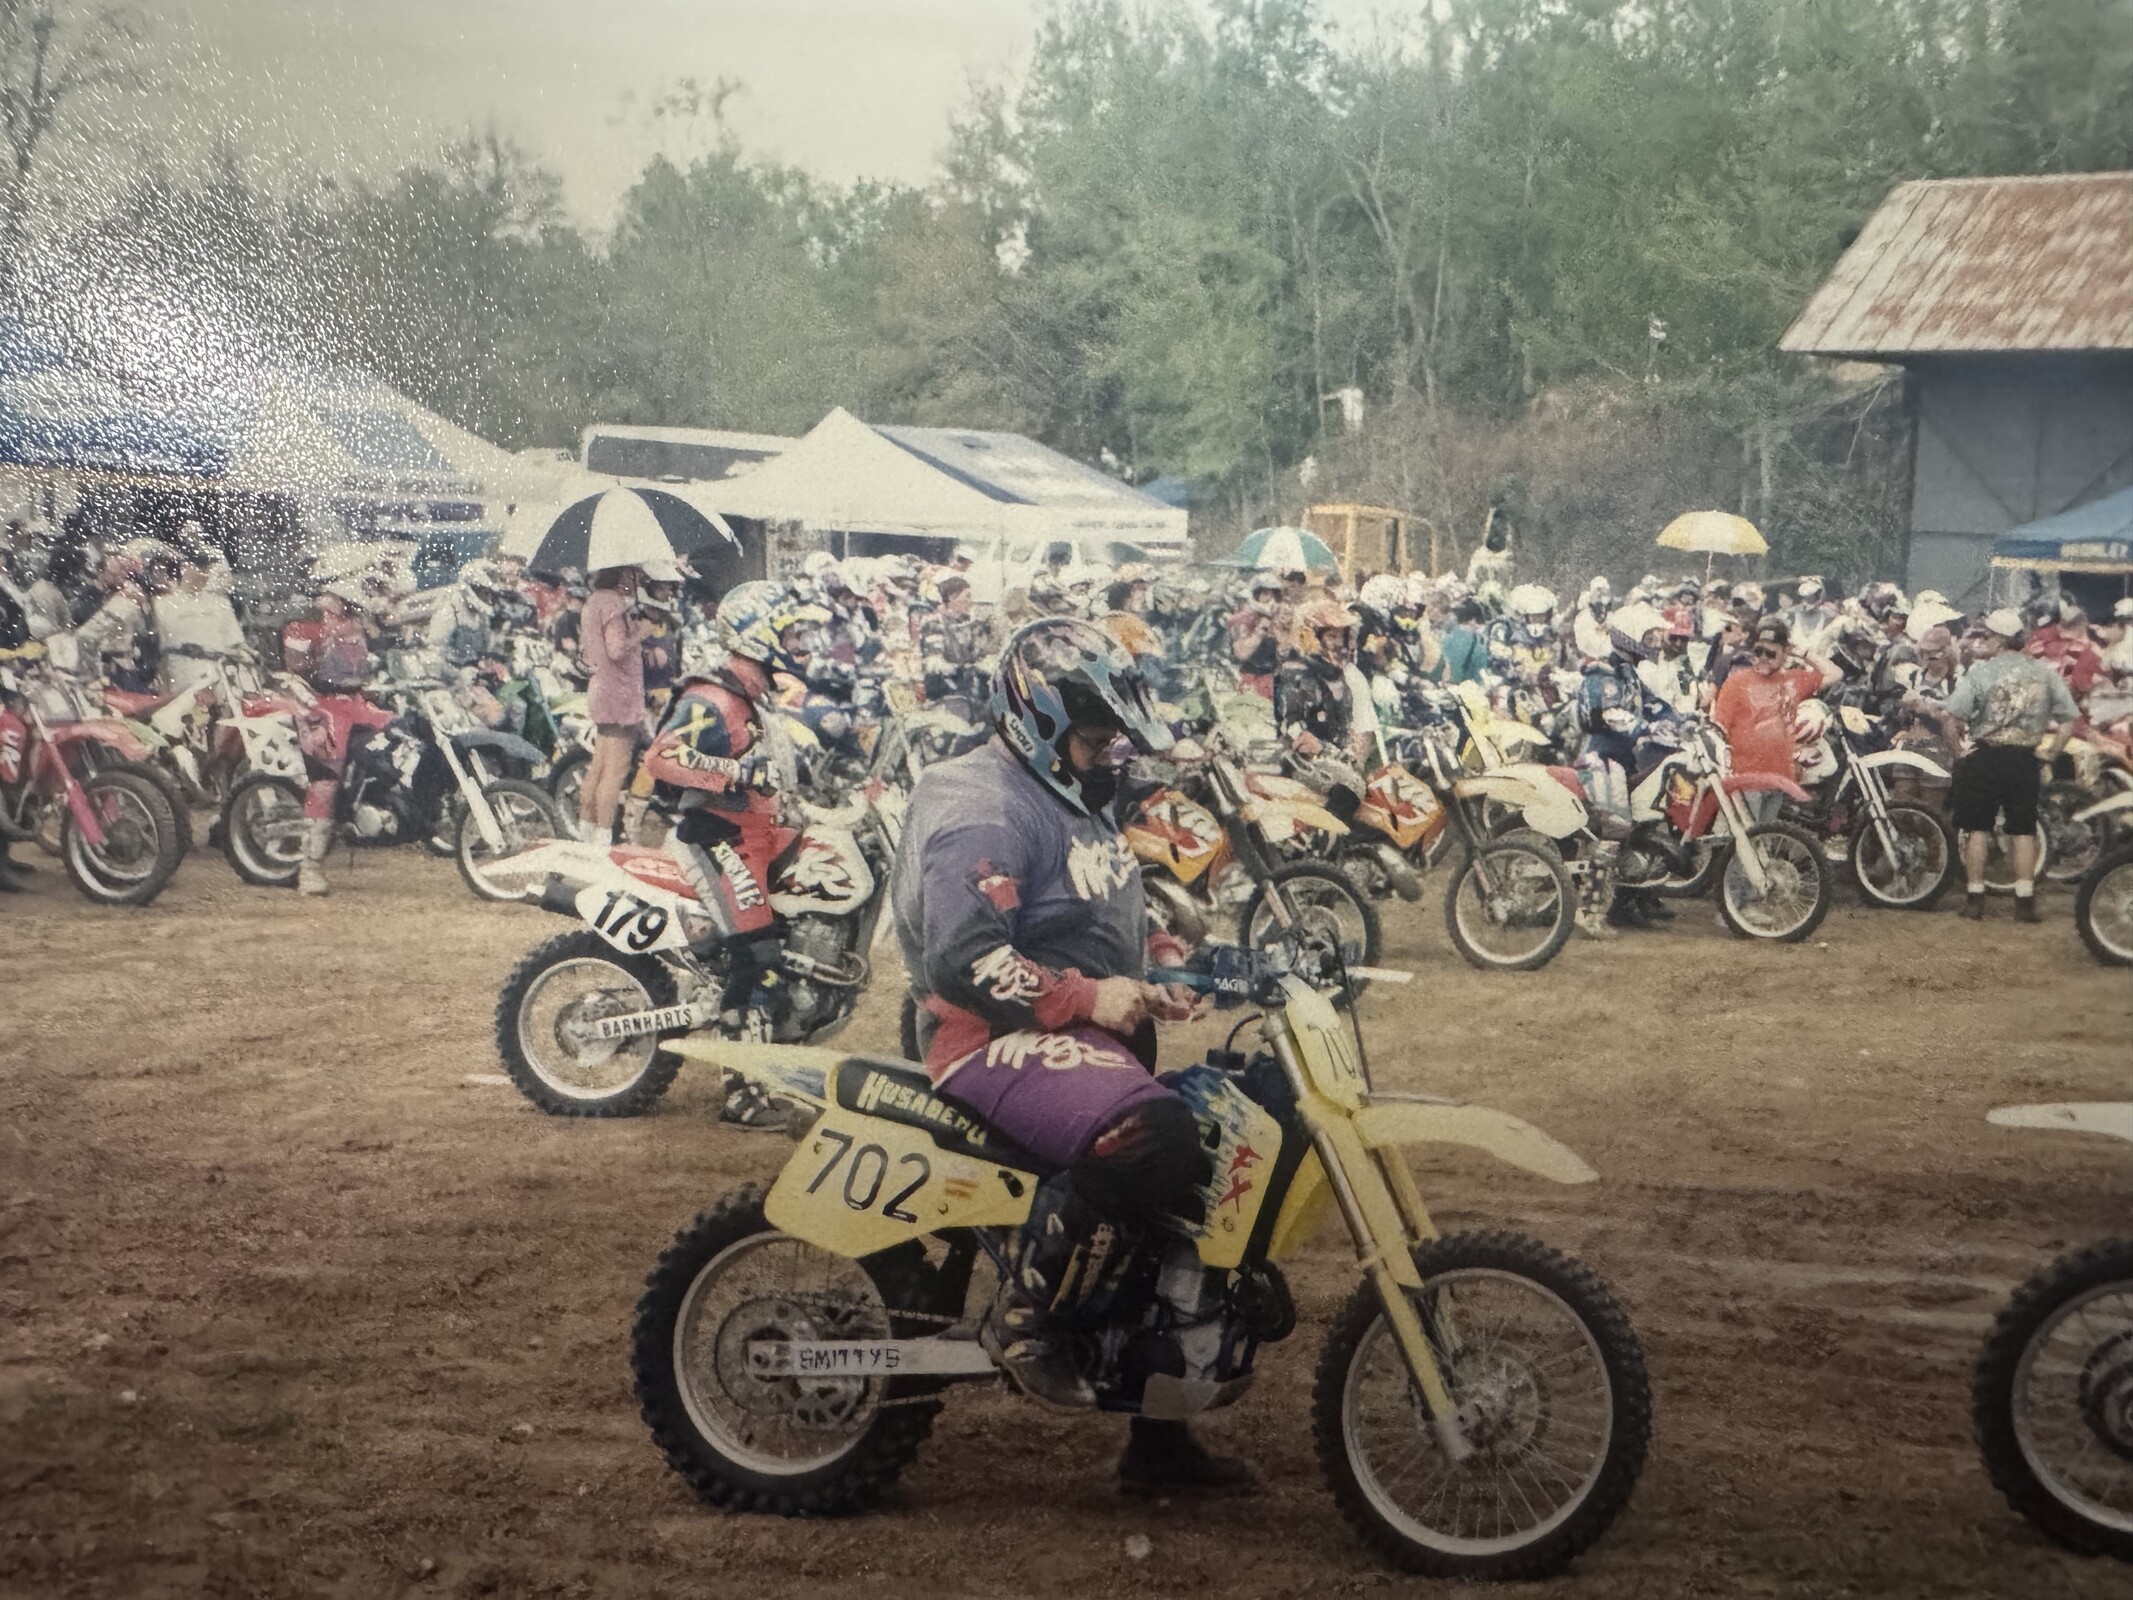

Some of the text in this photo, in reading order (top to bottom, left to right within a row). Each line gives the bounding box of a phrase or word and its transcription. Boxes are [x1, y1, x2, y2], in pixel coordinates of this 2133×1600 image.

[594, 888, 669, 951] 179
[601, 1007, 693, 1038] BARNHARTS
[805, 1127, 932, 1224] 702
[799, 1347, 900, 1370] SMITTYS
